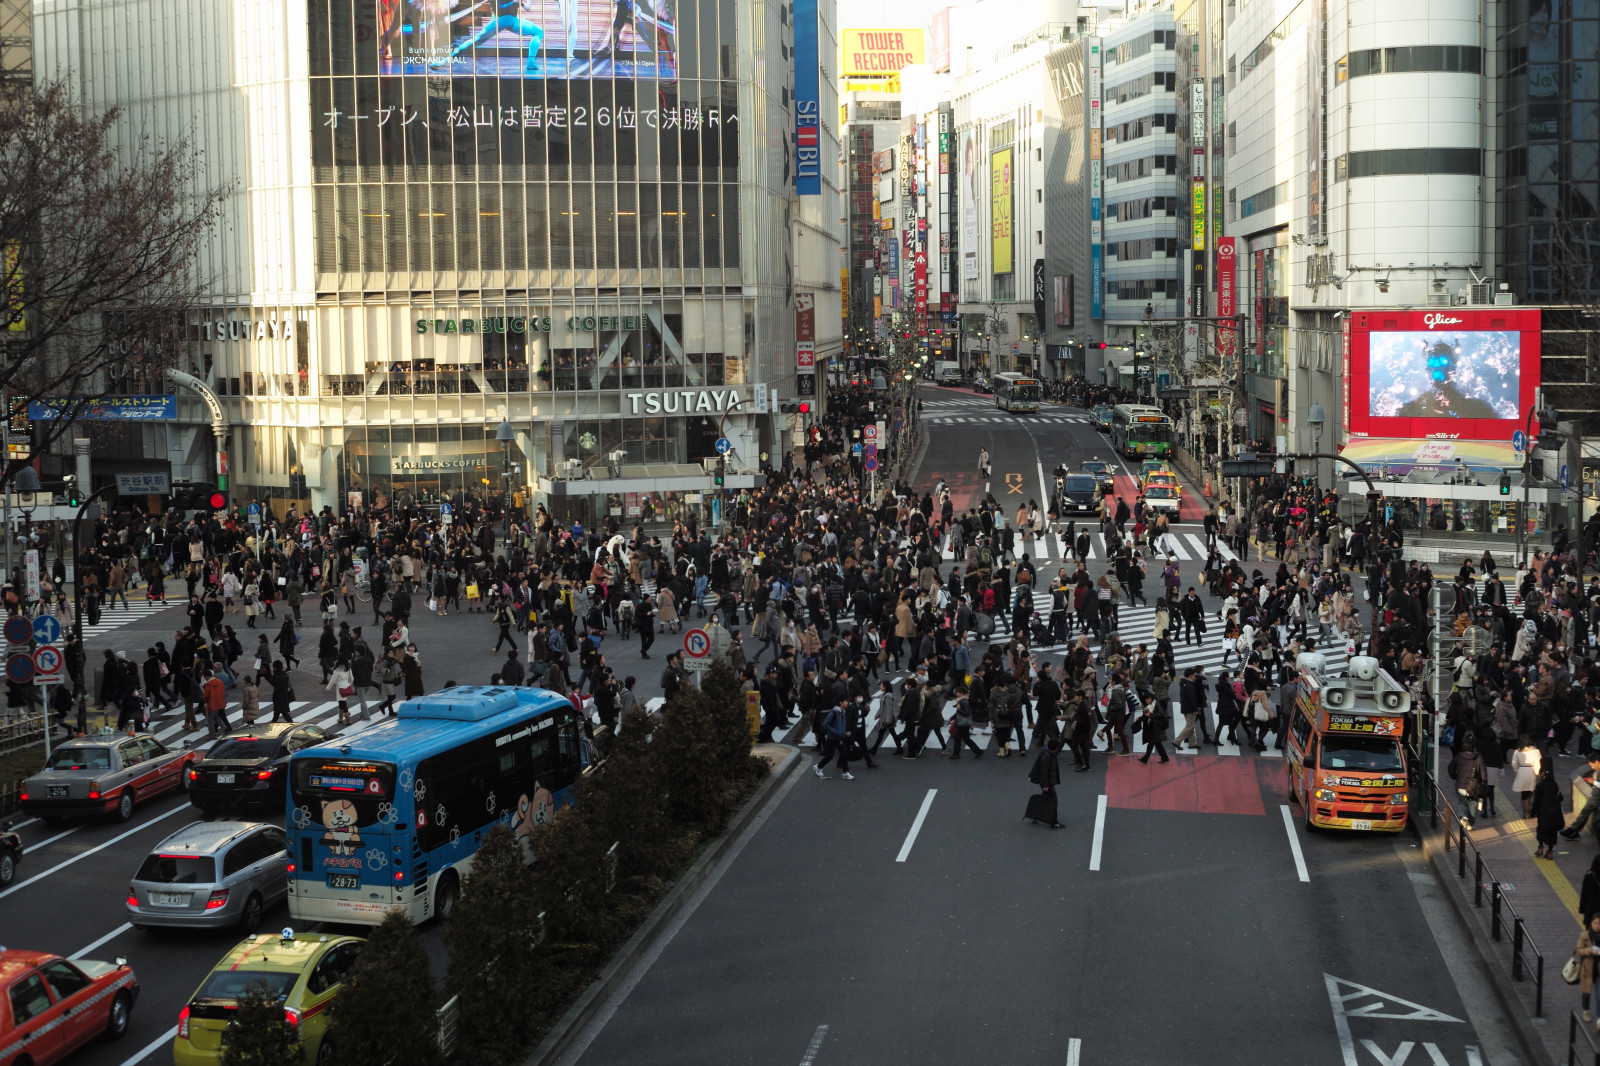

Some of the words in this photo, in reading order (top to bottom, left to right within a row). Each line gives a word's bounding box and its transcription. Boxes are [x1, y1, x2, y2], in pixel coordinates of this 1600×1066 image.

[858, 32, 904, 50] TOWER
[853, 53, 913, 71] RECORDS
[1052, 61, 1083, 100] ZAR
[797, 100, 818, 178] SEIBU
[900, 135, 910, 196] KARAOKE
[1034, 265, 1044, 301] ZARA
[416, 316, 551, 334] STARBUCKS
[568, 314, 648, 332] COFFEE
[1424, 312, 1463, 329] Glico
[203, 319, 294, 341] TSUTAYA
[799, 352, 812, 365] 本
[1058, 346, 1072, 360] ZARA
[627, 390, 742, 414] TSUTAYA
[392, 460, 451, 470] STARBUCKS
[453, 458, 487, 468] COFFEE
[120, 475, 164, 486] 渋谷駅前
[369, 781, 379, 793] Q
[418, 813, 424, 825] Q
[323, 857, 362, 868] ハチ公バス
[335, 877, 357, 888] 28-73
